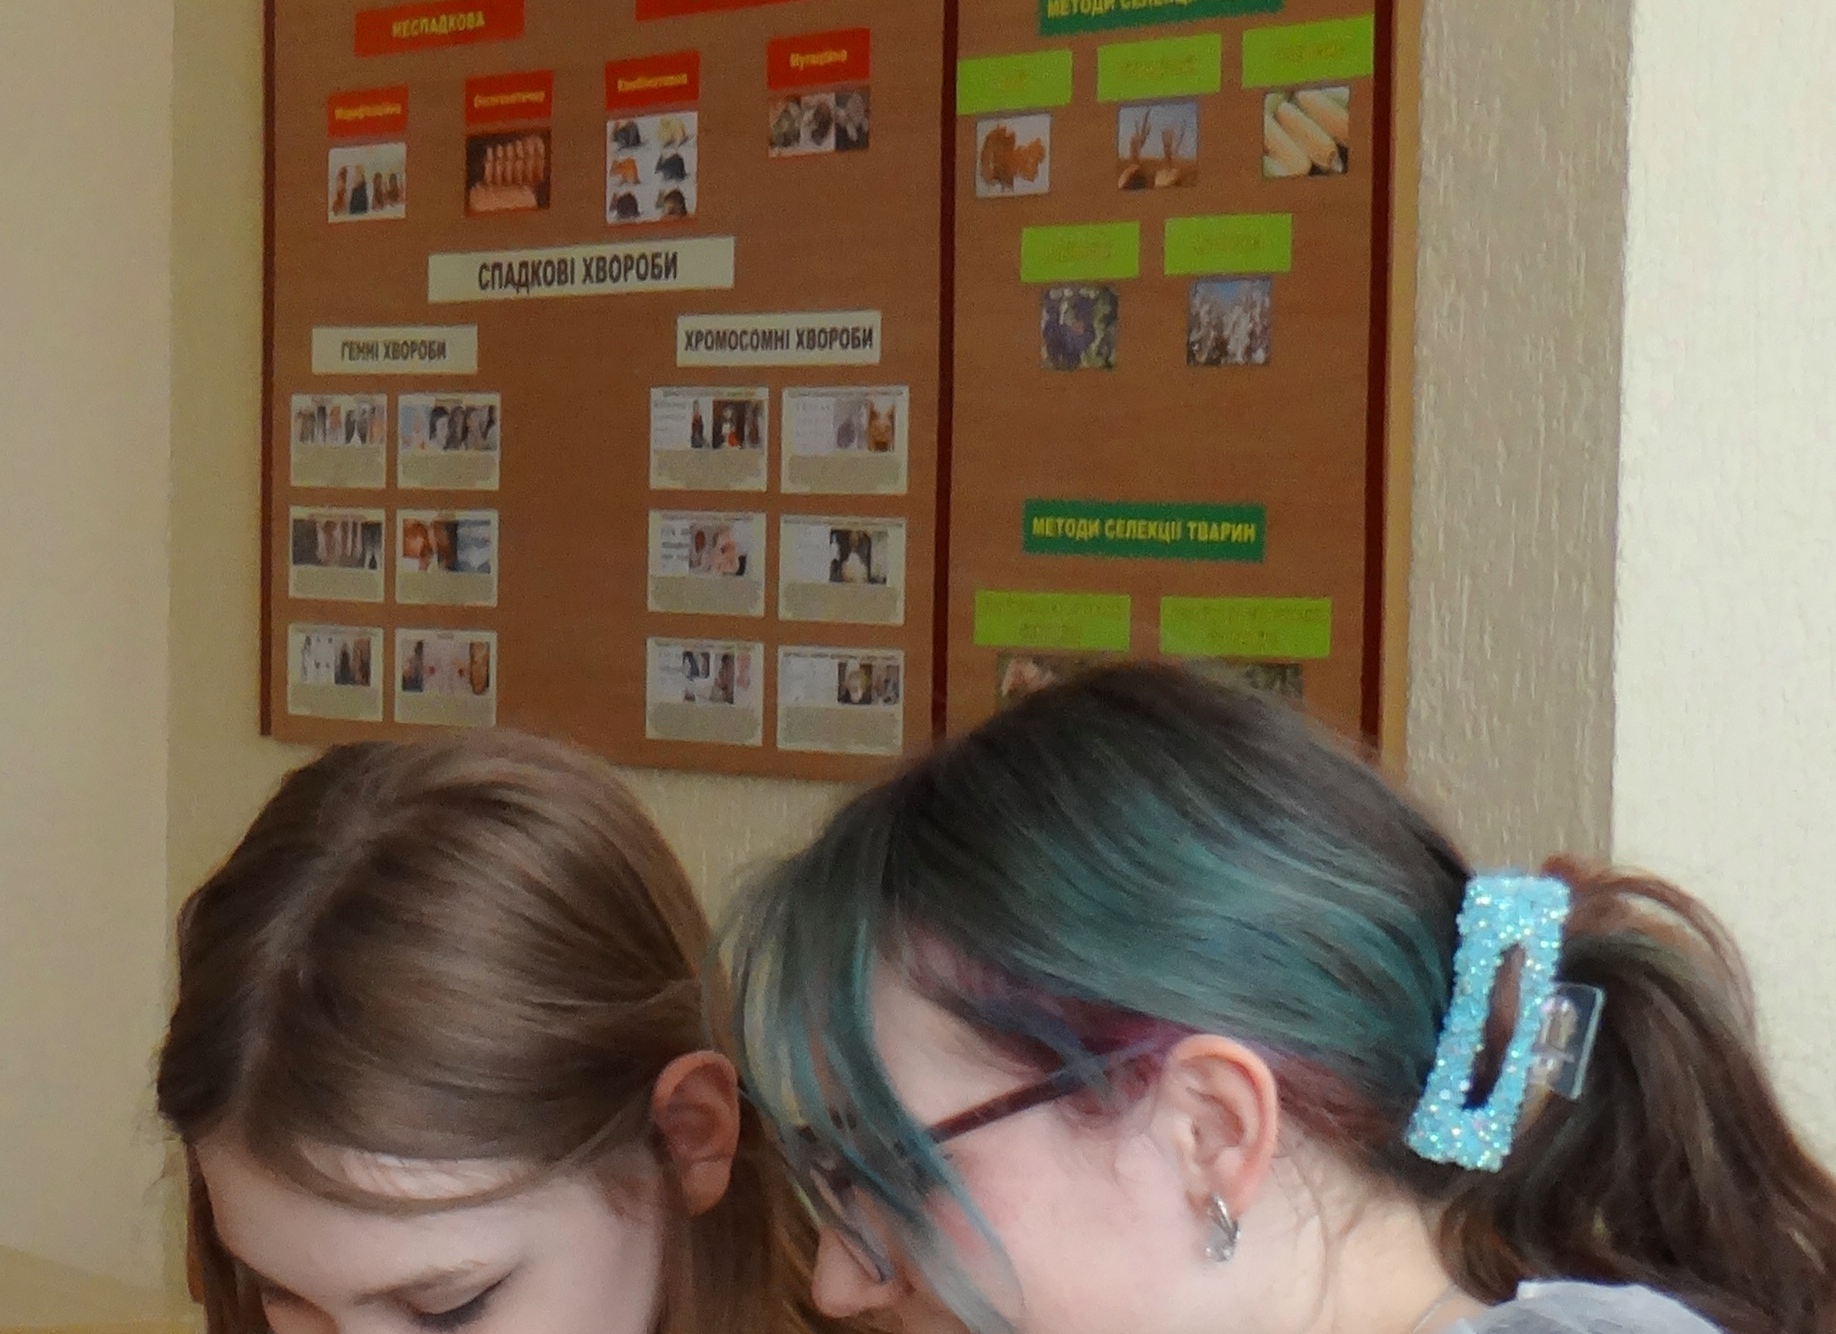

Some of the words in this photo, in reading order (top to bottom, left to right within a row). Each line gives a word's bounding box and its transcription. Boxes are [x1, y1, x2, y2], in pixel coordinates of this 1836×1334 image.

[391, 10, 485, 39] НЕСПАДКОВА
[477, 256, 575, 294] СПАДКОВІ
[581, 251, 678, 284] ХВОРОБИ
[340, 340, 379, 361] ГЕННІ
[383, 339, 447, 361] ХВОРОБИ
[684, 328, 790, 351] ХРОМОСОМНІ
[795, 326, 873, 350] ХВОРОБИ
[1032, 516, 1100, 541] МЕТОДИ
[1104, 517, 1182, 543] СЕЛЕКЦІЇ
[1186, 520, 1256, 544] ТВАРИН
